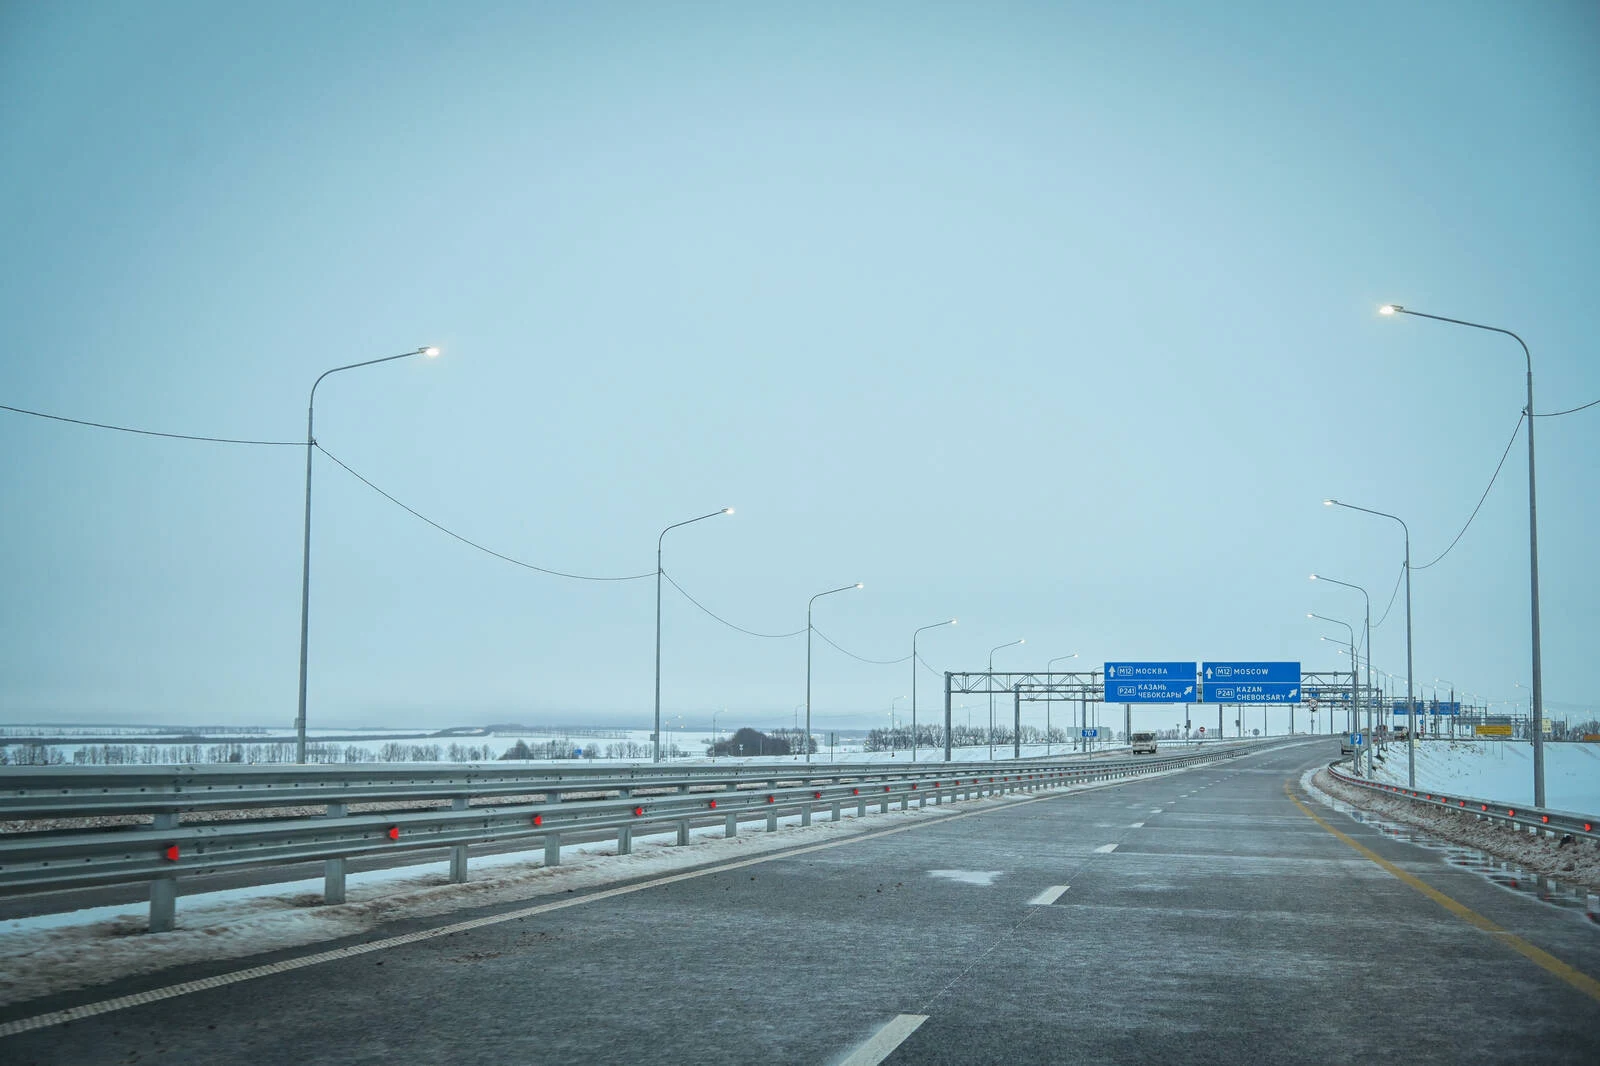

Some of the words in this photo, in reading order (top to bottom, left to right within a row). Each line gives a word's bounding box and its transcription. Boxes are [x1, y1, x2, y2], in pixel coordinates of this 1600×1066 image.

[1135, 667, 1168, 675] МОСКВА
[1137, 683, 1167, 691] КАЗАНЬ
[1137, 691, 1182, 699] ЧЕБОКСАРЫ
